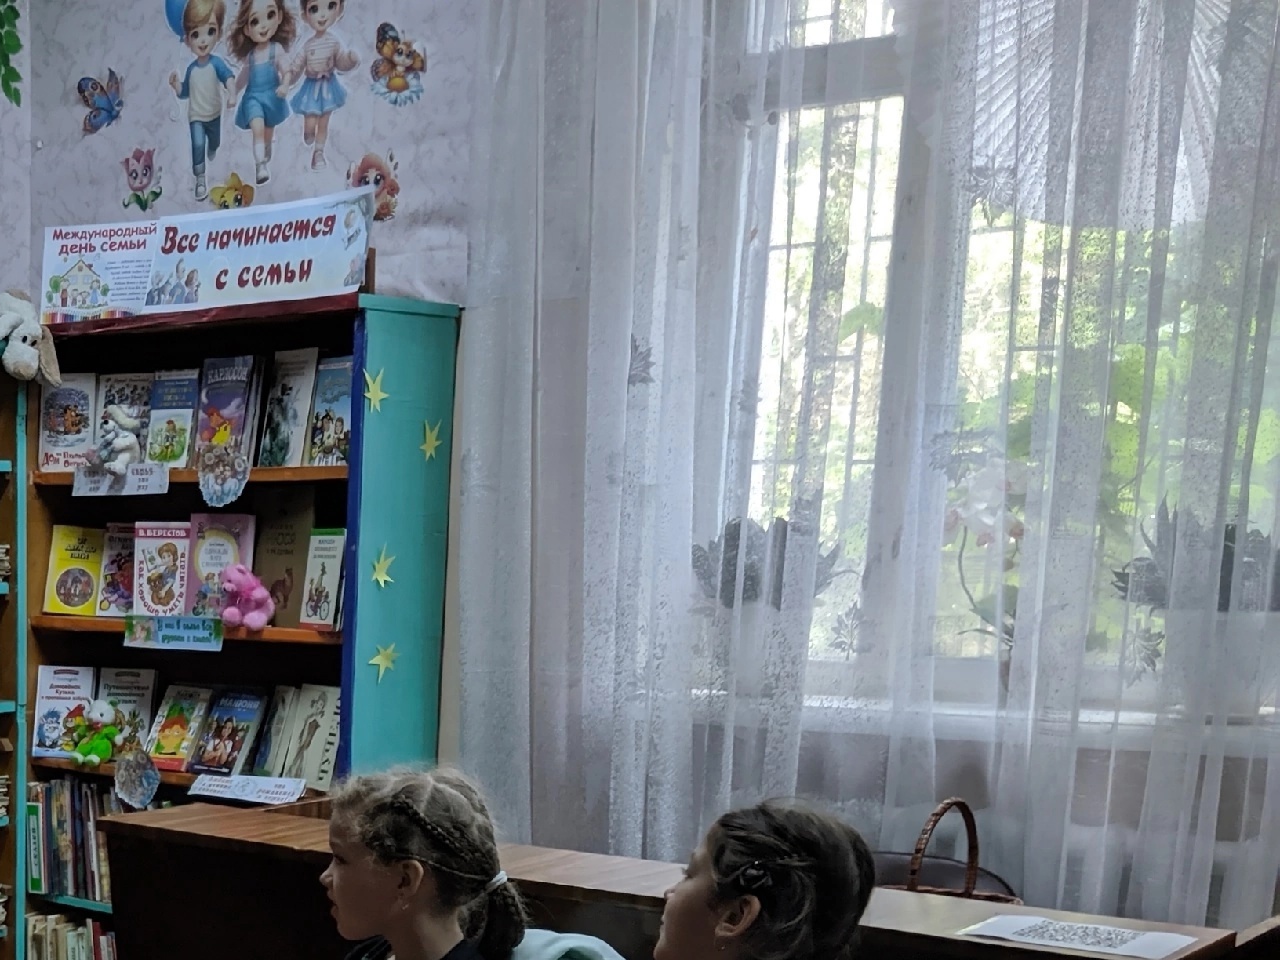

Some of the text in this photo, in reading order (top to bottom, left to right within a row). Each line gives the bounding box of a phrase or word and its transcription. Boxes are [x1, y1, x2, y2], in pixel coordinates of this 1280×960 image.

[52, 222, 157, 242] Международный
[206, 214, 337, 250] начинается
[58, 239, 147, 256] день семьи
[215, 259, 313, 290] с семьи
[138, 527, 188, 538] В.БЕРЕСТОВ
